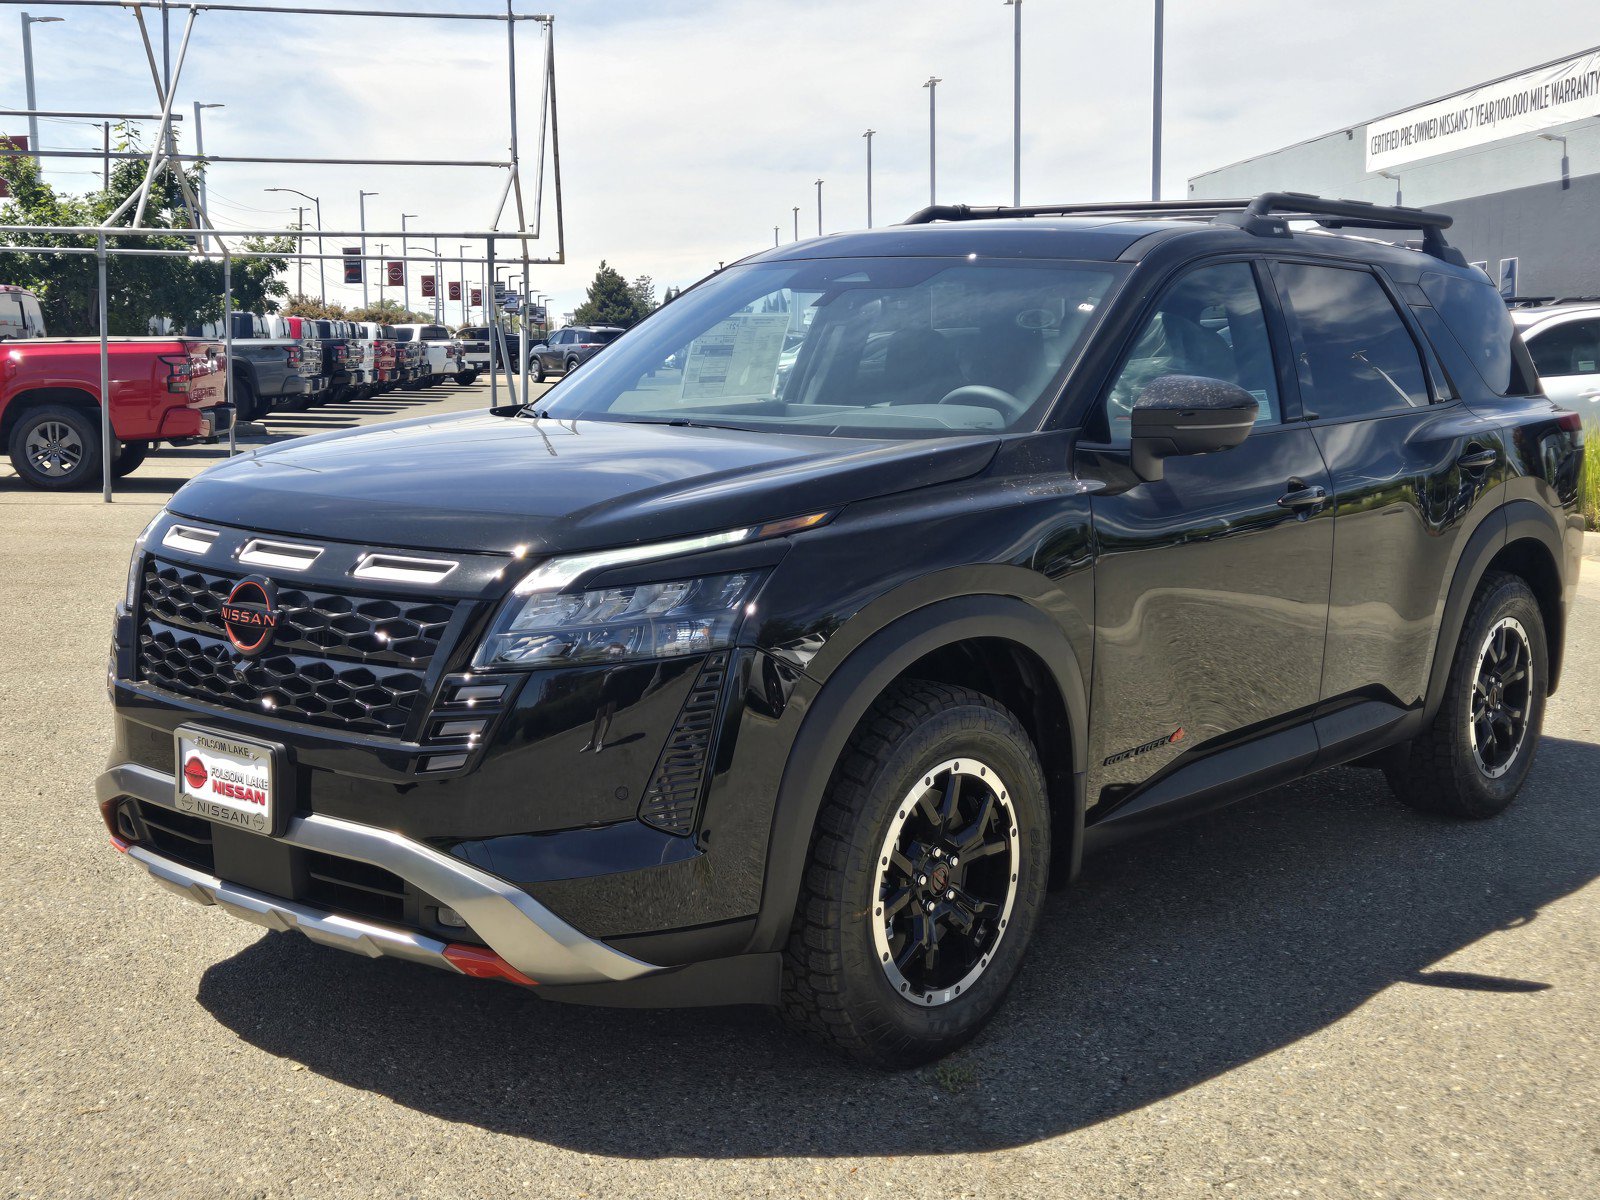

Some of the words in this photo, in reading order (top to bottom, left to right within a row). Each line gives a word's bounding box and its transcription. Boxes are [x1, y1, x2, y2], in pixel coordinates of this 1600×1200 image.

[1371, 134, 1399, 155] CERTIFIED
[1400, 118, 1438, 148] PRE-OWNED
[1439, 113, 1468, 137] NISSANS
[1469, 108, 1475, 130] 7
[1475, 90, 1529, 128] YEAR/100,000
[1530, 84, 1549, 112] MILE
[1551, 70, 1600, 106] WARRANTY
[221, 606, 275, 627] NISSAN
[197, 736, 227, 752] FOLSOM
[228, 744, 249, 757] LAKE
[211, 767, 244, 784] FOLSOM
[245, 774, 269, 790] LAKE
[212, 779, 266, 806] NISSAN
[197, 801, 249, 825] NISSAN
